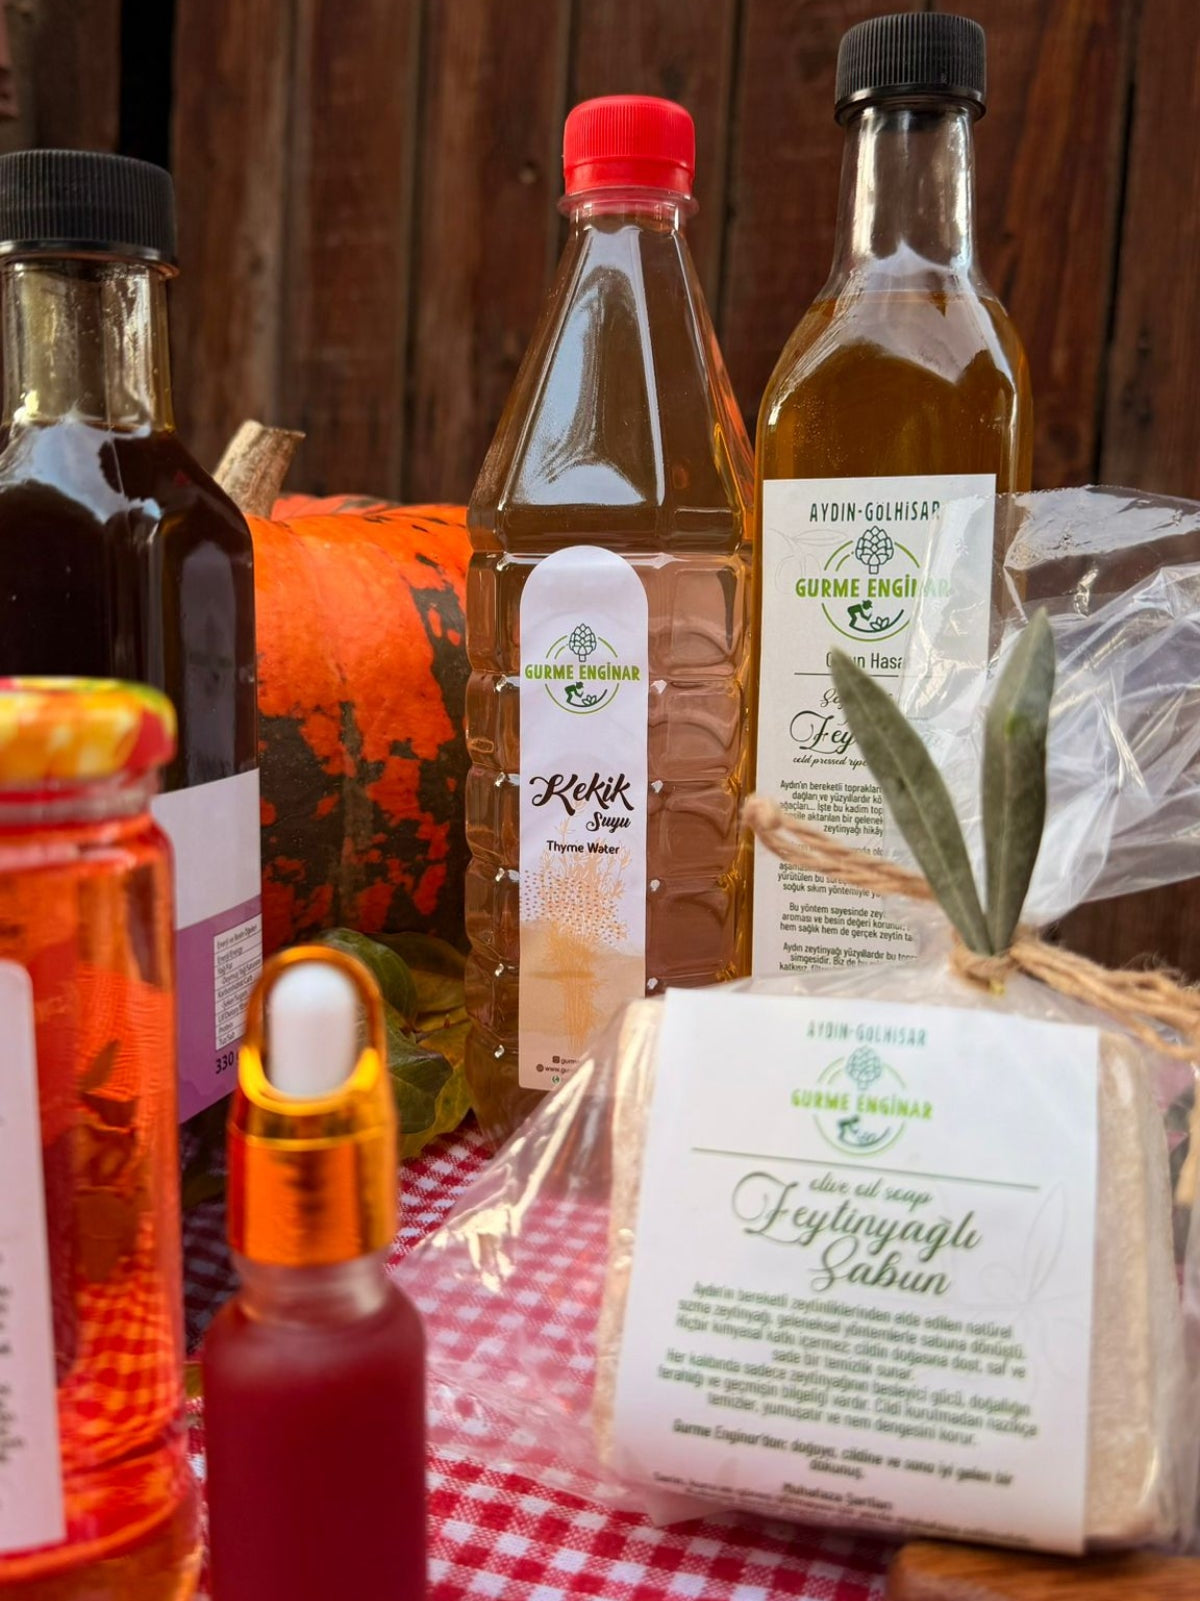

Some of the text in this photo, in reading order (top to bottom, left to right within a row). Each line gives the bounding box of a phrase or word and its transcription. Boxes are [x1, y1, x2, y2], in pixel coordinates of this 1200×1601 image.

[795, 578, 860, 598] GURME
[525, 661, 641, 681] GURME ENGİNAR
[790, 710, 856, 755] Zey
[529, 772, 634, 816] Kekik
[820, 793, 828, 801] ve
[833, 803, 843, 812] bu
[586, 811, 631, 833] Suyu
[842, 814, 852, 823] bir
[547, 840, 620, 855] Thyme Water
[815, 873, 825, 882] bu
[783, 883, 805, 893] soğuk
[789, 902, 800, 911] Bu
[800, 904, 829, 915] yöntem
[830, 907, 869, 918] sayesinde
[813, 915, 823, 923] ve
[824, 916, 845, 925] besin
[780, 922, 797, 931] hem
[821, 926, 839, 935] hem
[840, 926, 850, 935] de
[879, 931, 903, 941] zeytin
[783, 942, 803, 952] Aydın
[886, 951, 896, 960] bu
[216, 1051, 234, 1075] 330
[791, 1088, 849, 1112] GURME
[809, 1172, 933, 1211] olive oil soap
